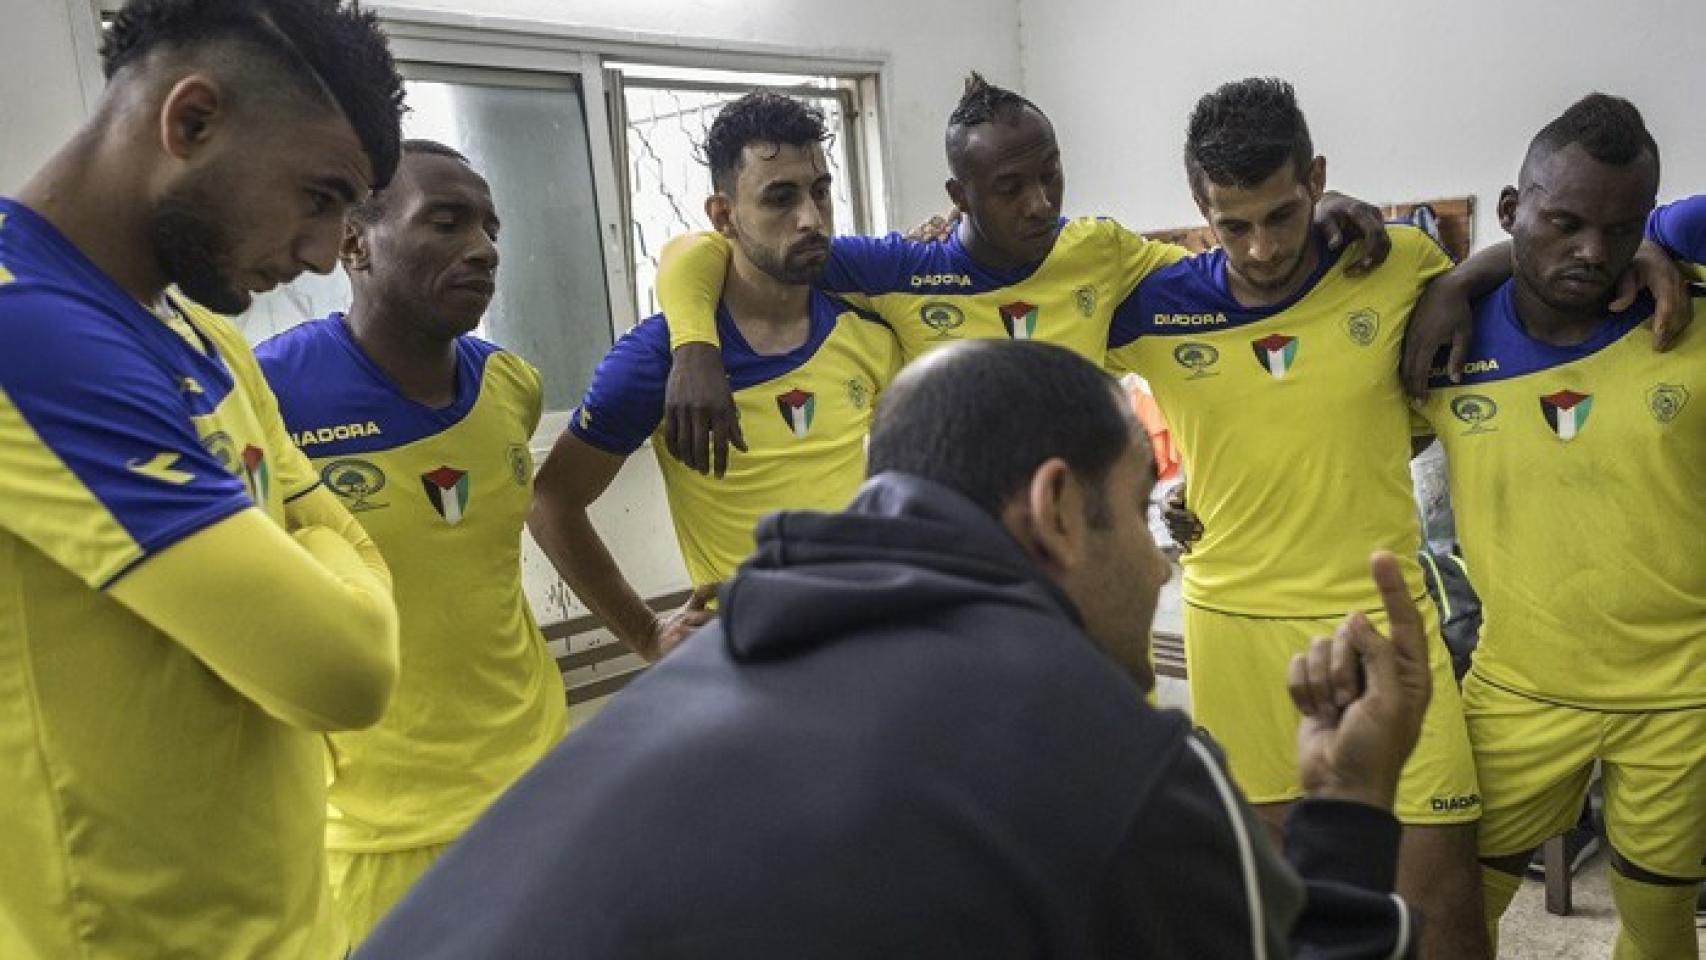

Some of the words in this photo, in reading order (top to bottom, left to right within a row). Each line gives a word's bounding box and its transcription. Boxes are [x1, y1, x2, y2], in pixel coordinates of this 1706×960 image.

[911, 274, 972, 286] DIADORA
[1154, 312, 1228, 326] DIADORA
[290, 421, 381, 447] IADORA
